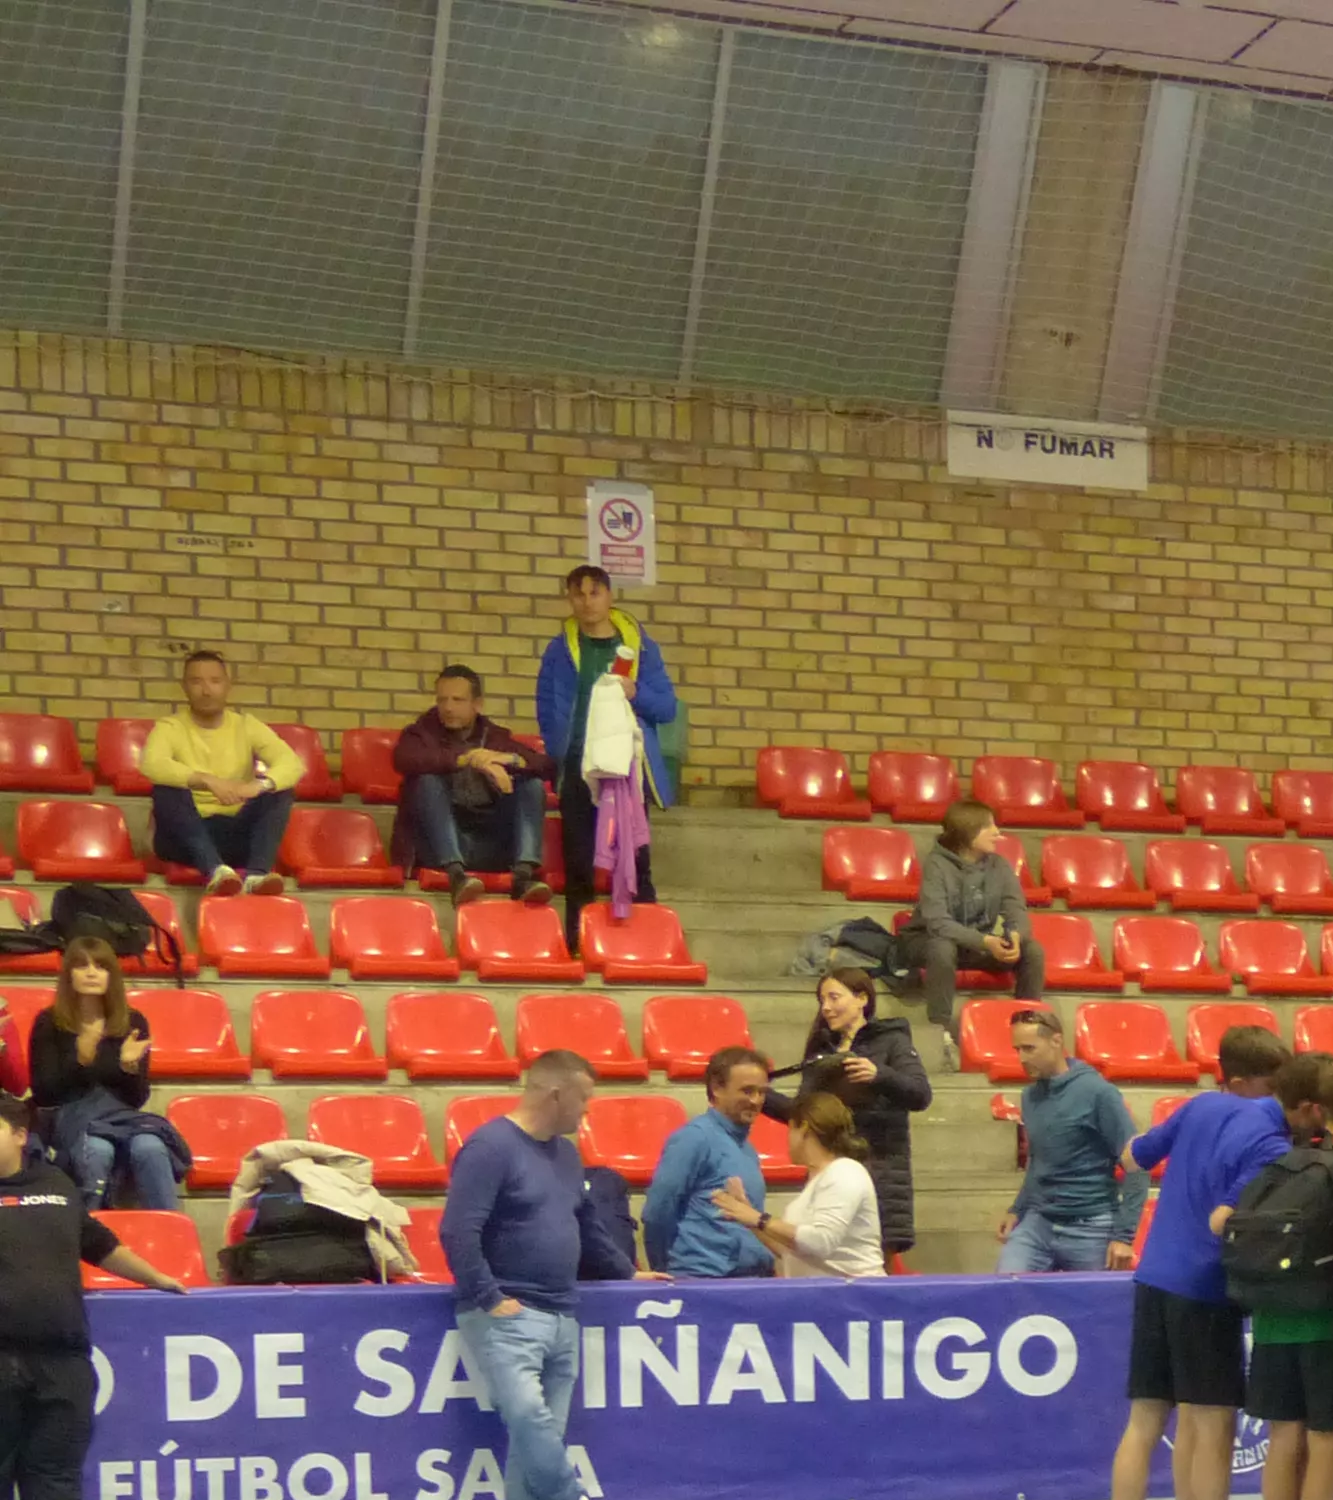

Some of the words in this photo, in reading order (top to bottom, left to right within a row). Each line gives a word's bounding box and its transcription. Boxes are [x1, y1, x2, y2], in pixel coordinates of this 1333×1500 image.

[1024, 432, 1115, 459] FUMAR
[20, 1194, 68, 1206] JONES
[164, 1332, 306, 1421] DE
[352, 1299, 1078, 1417] SAIÑANIGO
